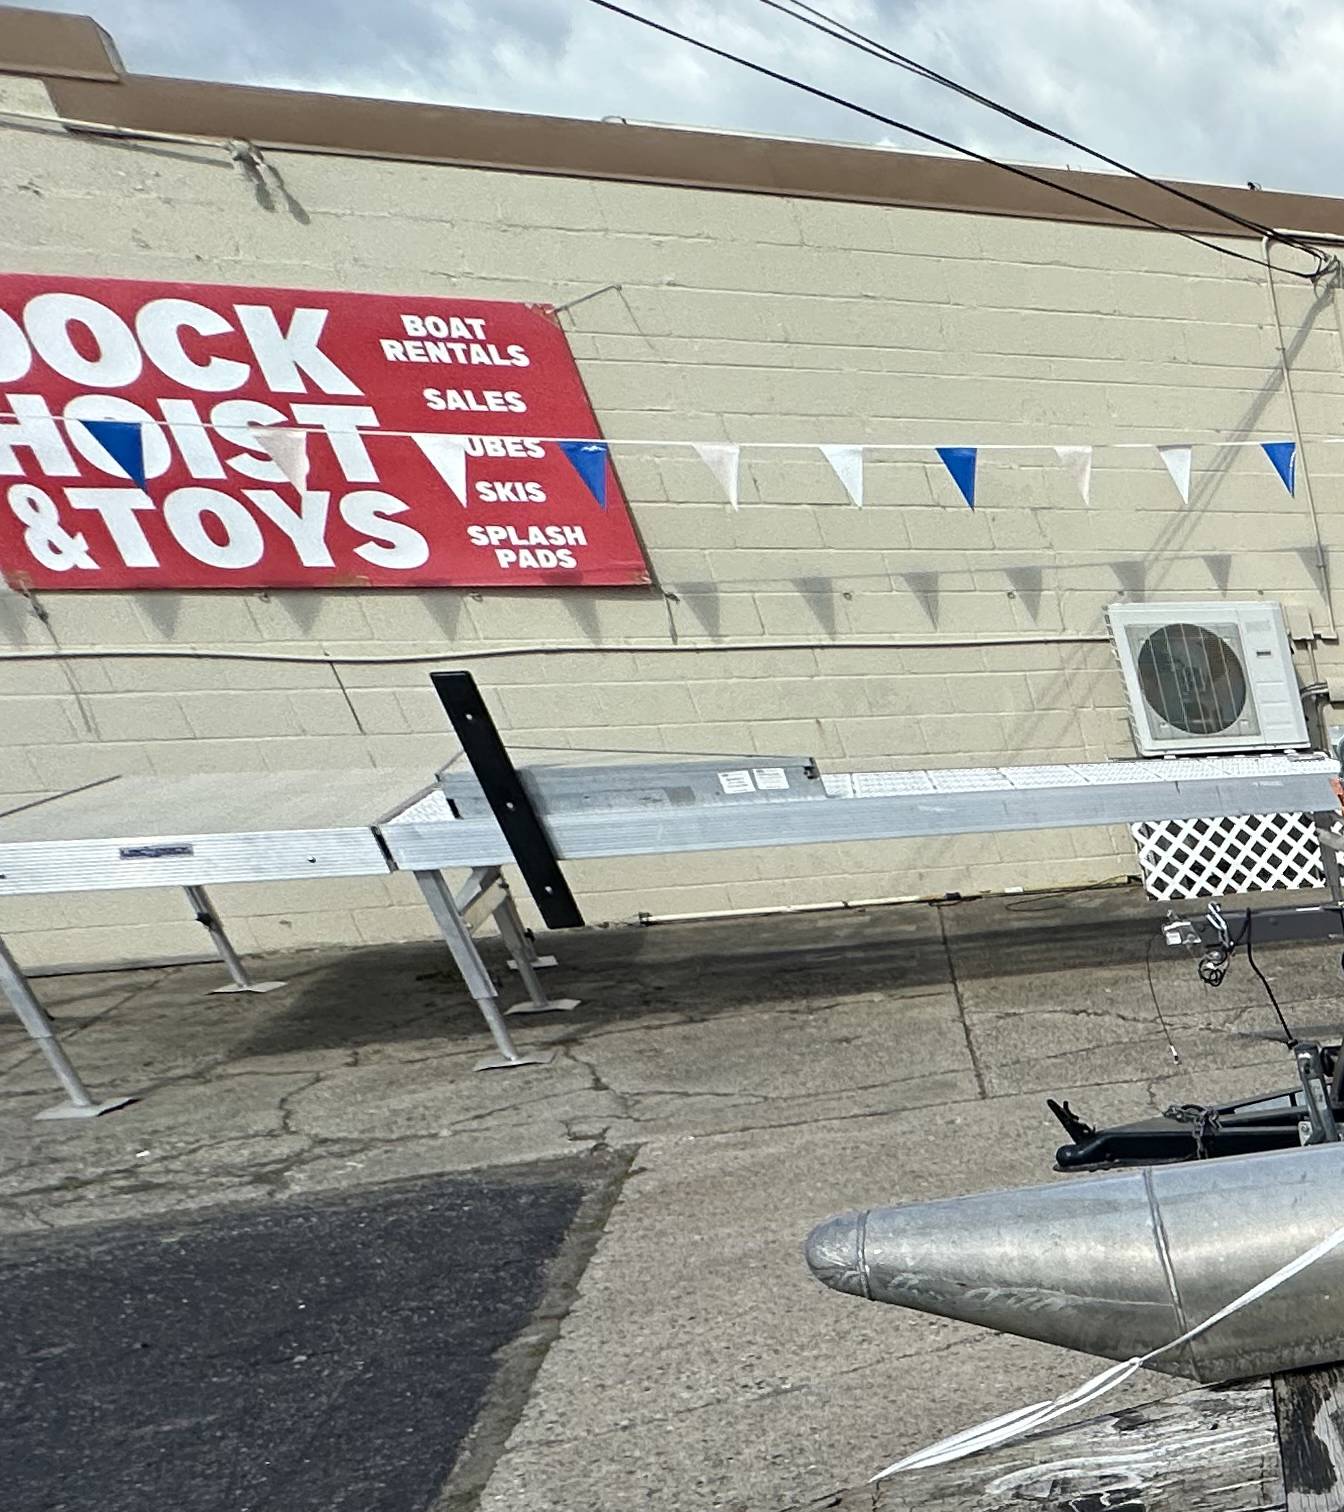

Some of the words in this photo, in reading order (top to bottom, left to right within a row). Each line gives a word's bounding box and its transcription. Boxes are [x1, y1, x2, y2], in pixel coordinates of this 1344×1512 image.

[401, 315, 487, 340] BOAT
[379, 339, 531, 368] RENTALS
[422, 387, 528, 414] SALES
[0, 392, 381, 483] HOIST
[463, 437, 546, 459] UBES
[475, 481, 547, 503] SKIS
[466, 525, 588, 546] SPLASH
[494, 549, 577, 569] PADS
